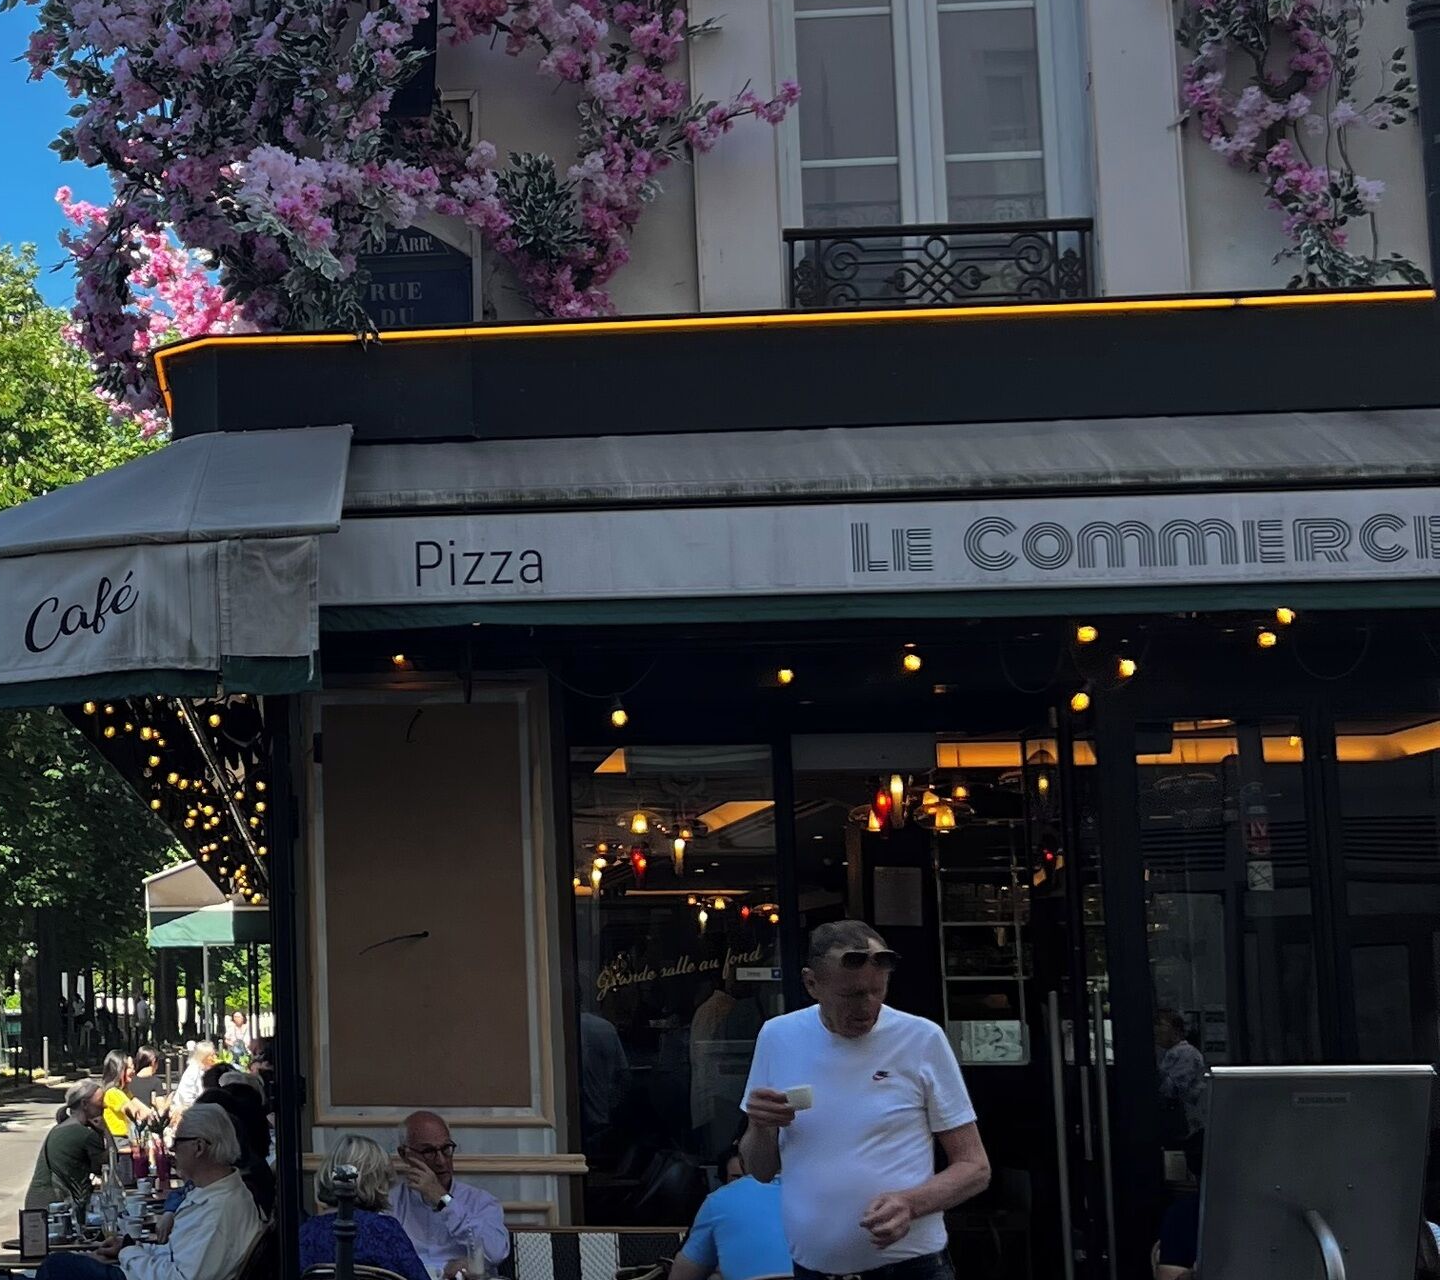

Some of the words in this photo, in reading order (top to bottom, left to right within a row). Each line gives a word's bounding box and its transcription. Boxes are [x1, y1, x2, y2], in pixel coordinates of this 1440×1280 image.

[370, 282, 423, 301] RUE
[381, 308, 417, 327] DU
[415, 540, 543, 587] Pizza
[851, 522, 934, 572] LE
[25, 570, 140, 653] Café
[596, 962, 657, 1001] Grande
[660, 954, 696, 979] salle
[699, 958, 720, 973] au
[722, 943, 763, 980] fond
